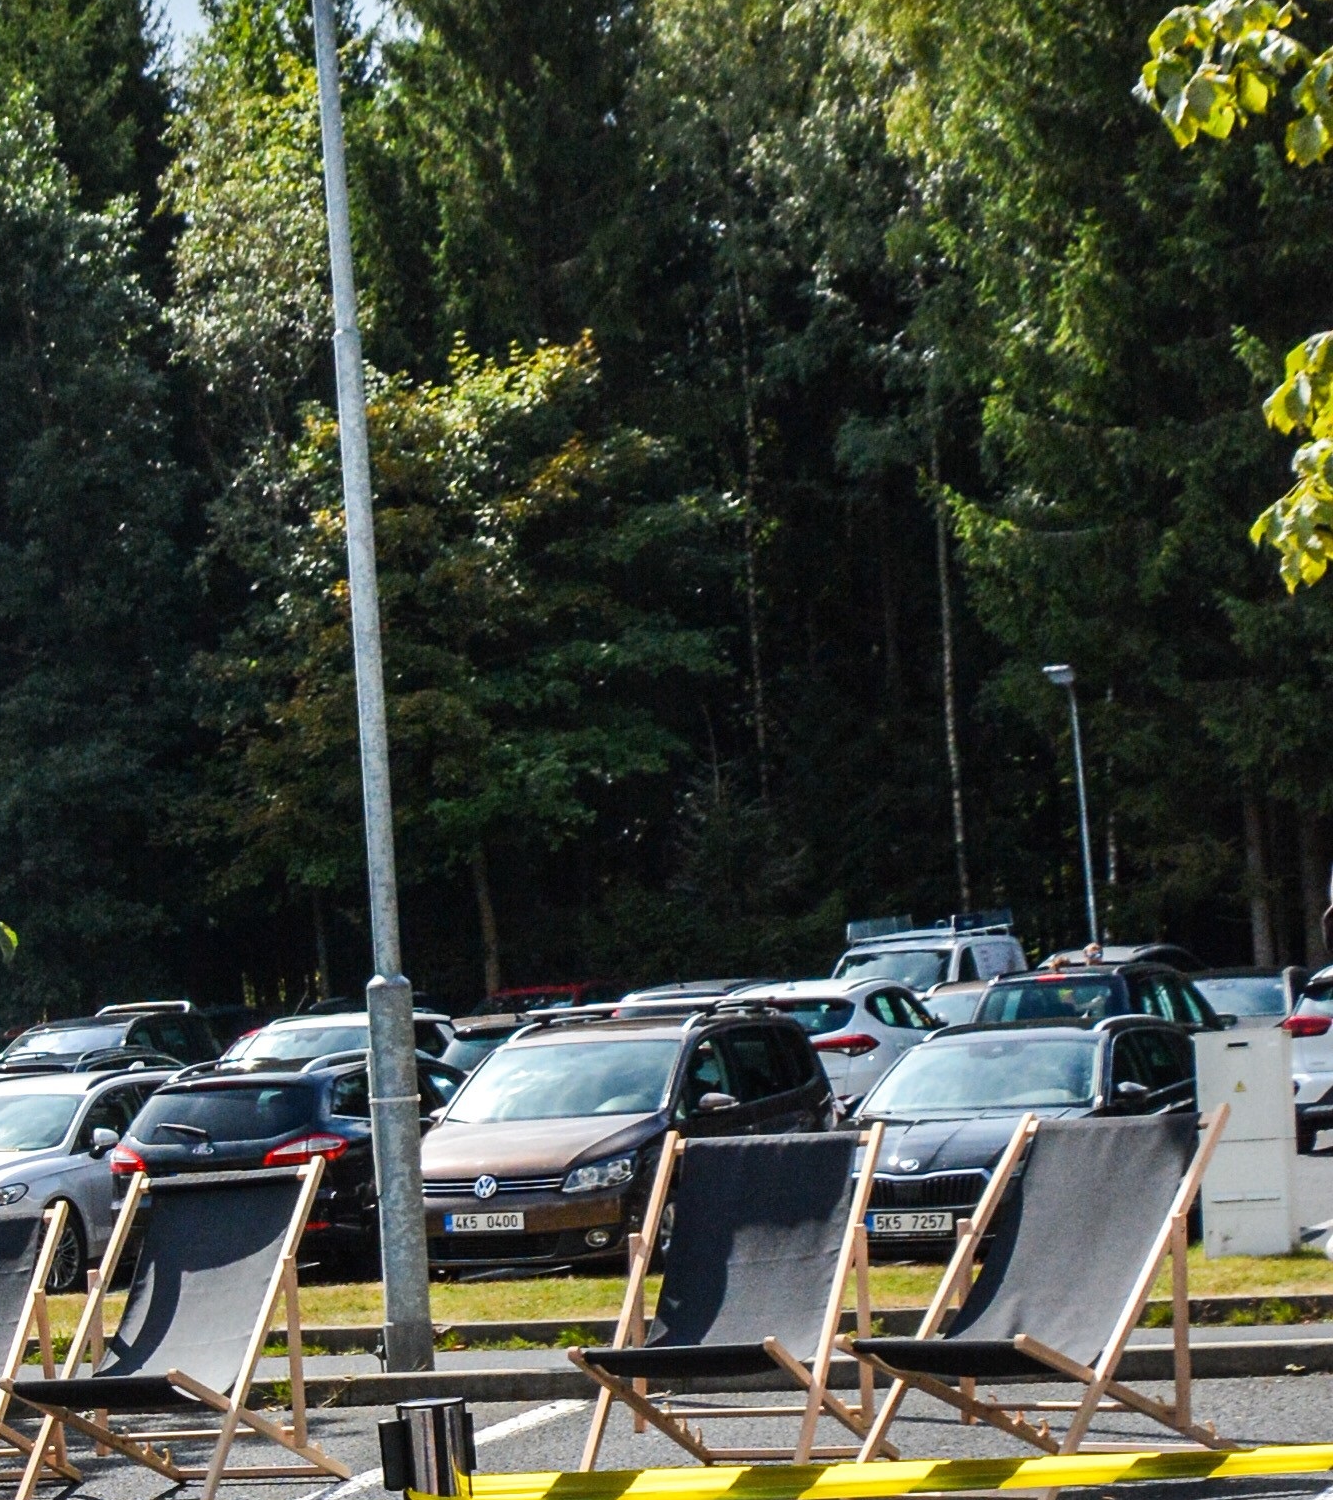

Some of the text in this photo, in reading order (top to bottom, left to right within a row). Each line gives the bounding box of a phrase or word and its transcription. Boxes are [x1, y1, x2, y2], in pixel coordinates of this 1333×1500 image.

[455, 1214, 518, 1229] 4K5 0400
[876, 1214, 945, 1230] 5K5 7257
